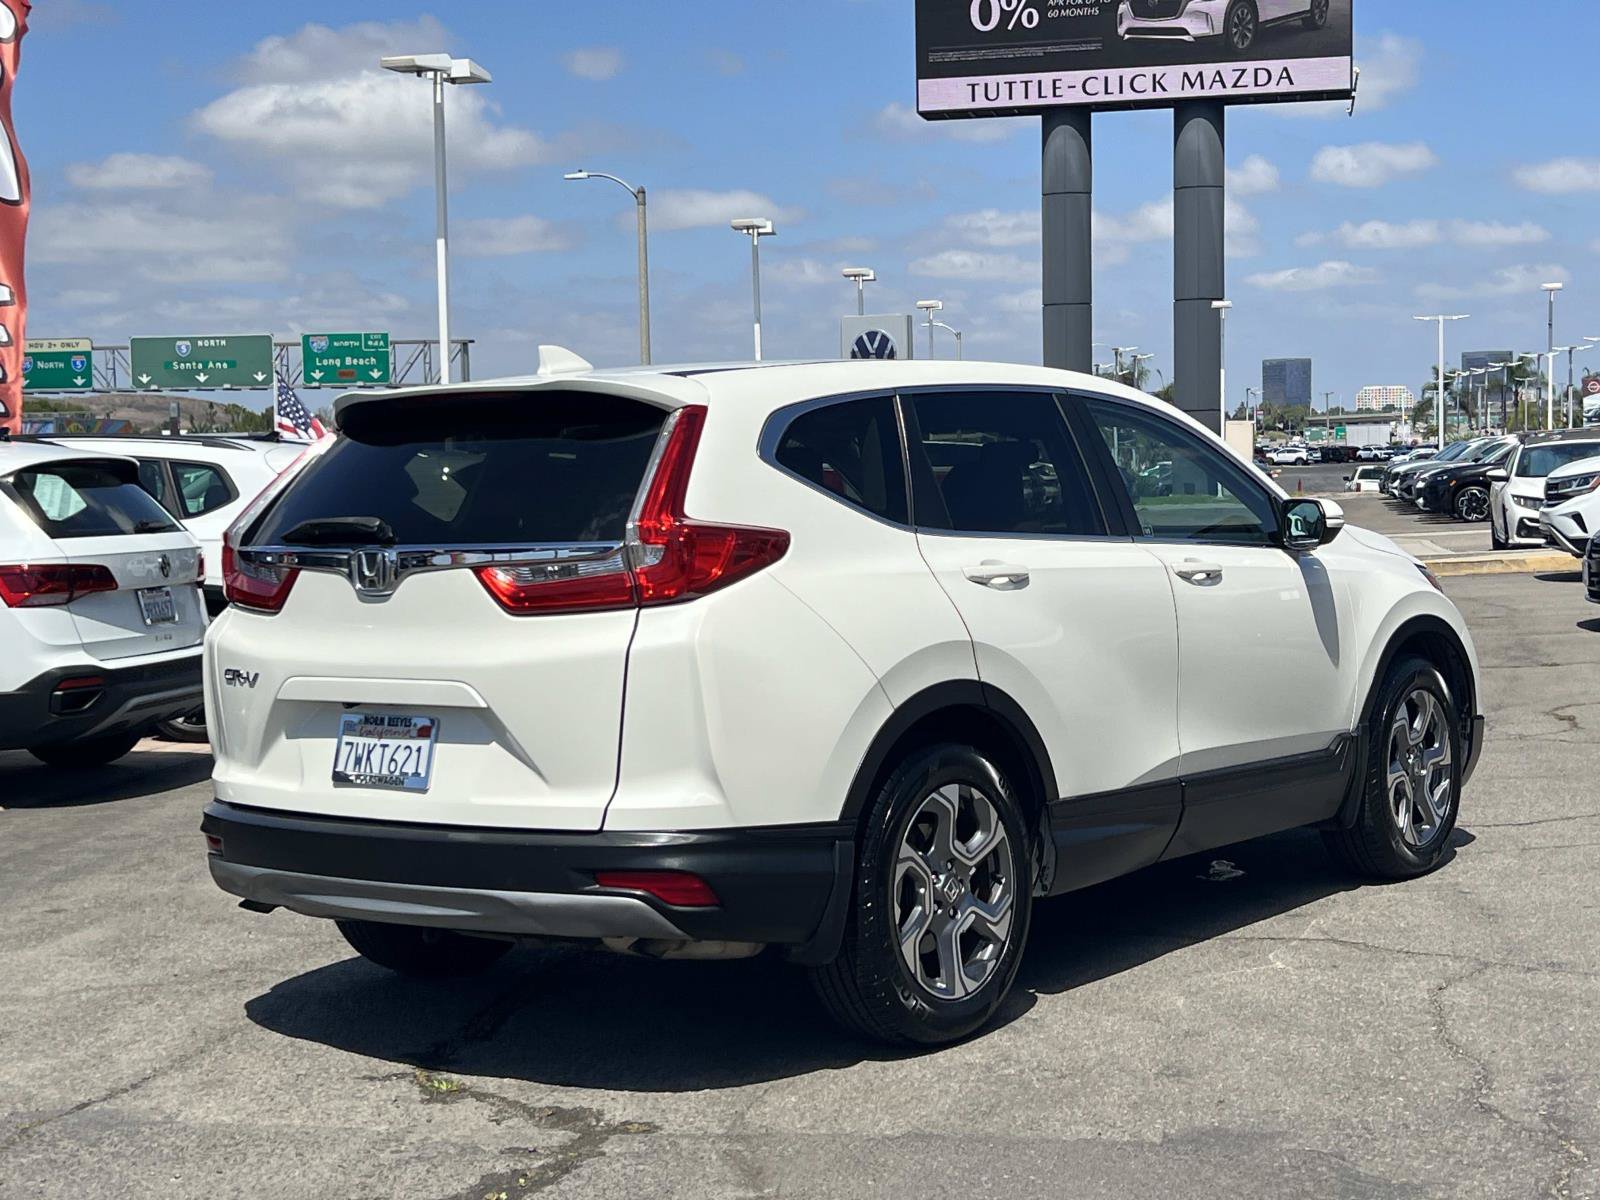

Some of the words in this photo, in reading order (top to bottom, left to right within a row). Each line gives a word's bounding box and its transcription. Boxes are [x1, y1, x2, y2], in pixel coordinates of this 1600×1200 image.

[969, 0, 1039, 32] 0%
[1048, 9, 1059, 18] 60
[1060, 7, 1100, 17] MONTHS
[967, 72, 1168, 102] TUTTLE-CLICK
[1180, 66, 1295, 91] MAZDA
[197, 339, 227, 347] NORTH
[181, 344, 187, 354] 5
[172, 361, 203, 370] Santa
[207, 360, 228, 369] Ana
[315, 357, 341, 367] Long
[345, 356, 377, 366] Beach
[224, 669, 260, 688] CR-V
[344, 741, 422, 777] 7WKT621
